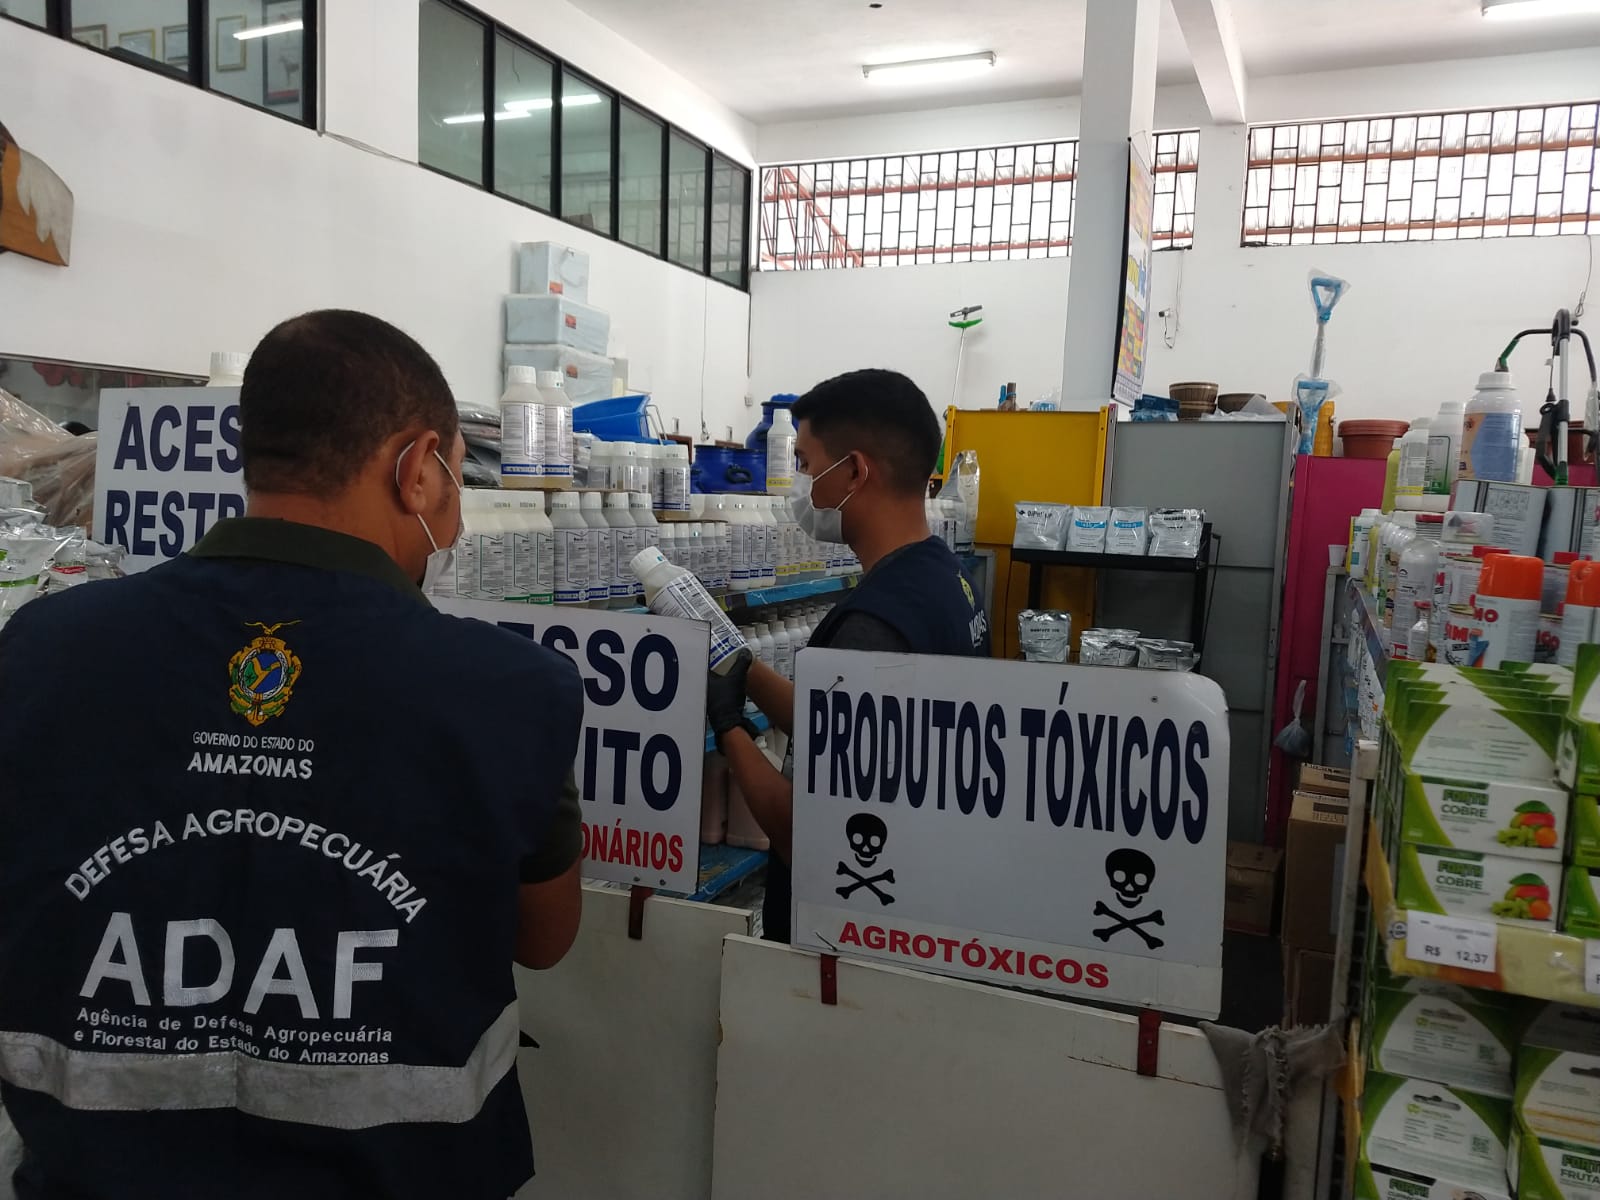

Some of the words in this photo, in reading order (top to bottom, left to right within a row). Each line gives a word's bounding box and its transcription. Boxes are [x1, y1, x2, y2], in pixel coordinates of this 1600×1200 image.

[192, 731, 240, 748] GOVERNO
[243, 735, 258, 749] DO
[261, 736, 295, 751] ESTADO
[298, 739, 314, 752] DO
[187, 752, 312, 780] AMAZONAS
[807, 688, 1006, 818] PRODUTOS
[1020, 681, 1210, 845] TÓXICOS
[1441, 804, 1488, 818] COBRE
[65, 820, 176, 901] DEFESA
[182, 809, 427, 924] AGROPECUÁRIA
[1435, 875, 1483, 890] COBRE
[79, 911, 399, 1019] ADAF
[838, 921, 1109, 988] AGROTÓXICOS
[1424, 945, 1441, 957] R$
[1456, 950, 1489, 965] 12,37
[77, 1006, 147, 1029] Agência
[159, 1017, 181, 1031] de
[194, 1015, 253, 1036] Defesa
[264, 1025, 392, 1046] Agropecuária
[74, 1030, 84, 1042] e
[92, 1030, 166, 1050] Florestal
[175, 1036, 198, 1051] do
[209, 1035, 260, 1056] Estado
[268, 1046, 289, 1061] do
[299, 1049, 389, 1064] Amazonas
